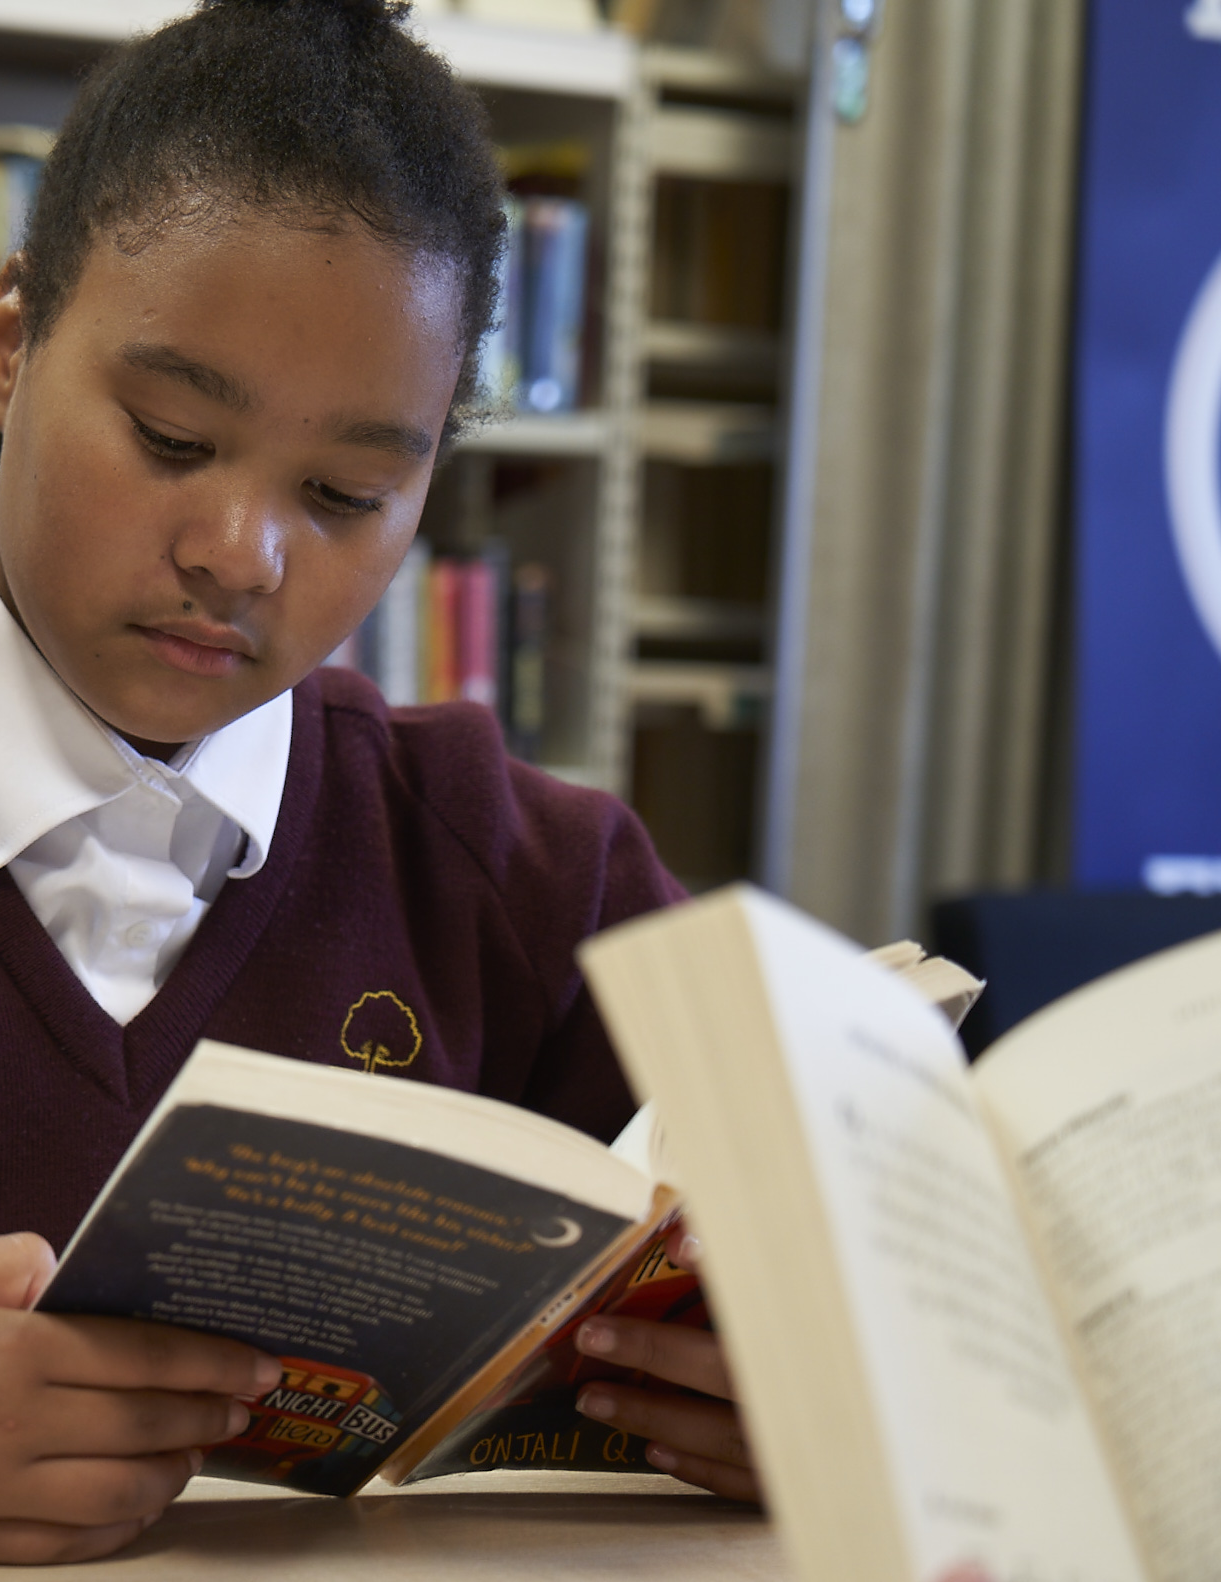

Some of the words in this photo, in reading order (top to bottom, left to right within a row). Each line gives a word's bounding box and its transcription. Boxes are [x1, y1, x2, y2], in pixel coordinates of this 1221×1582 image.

[265, 1388, 347, 1419] NIGHT
[344, 1409, 394, 1441] BUS
[271, 1417, 333, 1446] Hero
[469, 1431, 581, 1465] ONJALI
